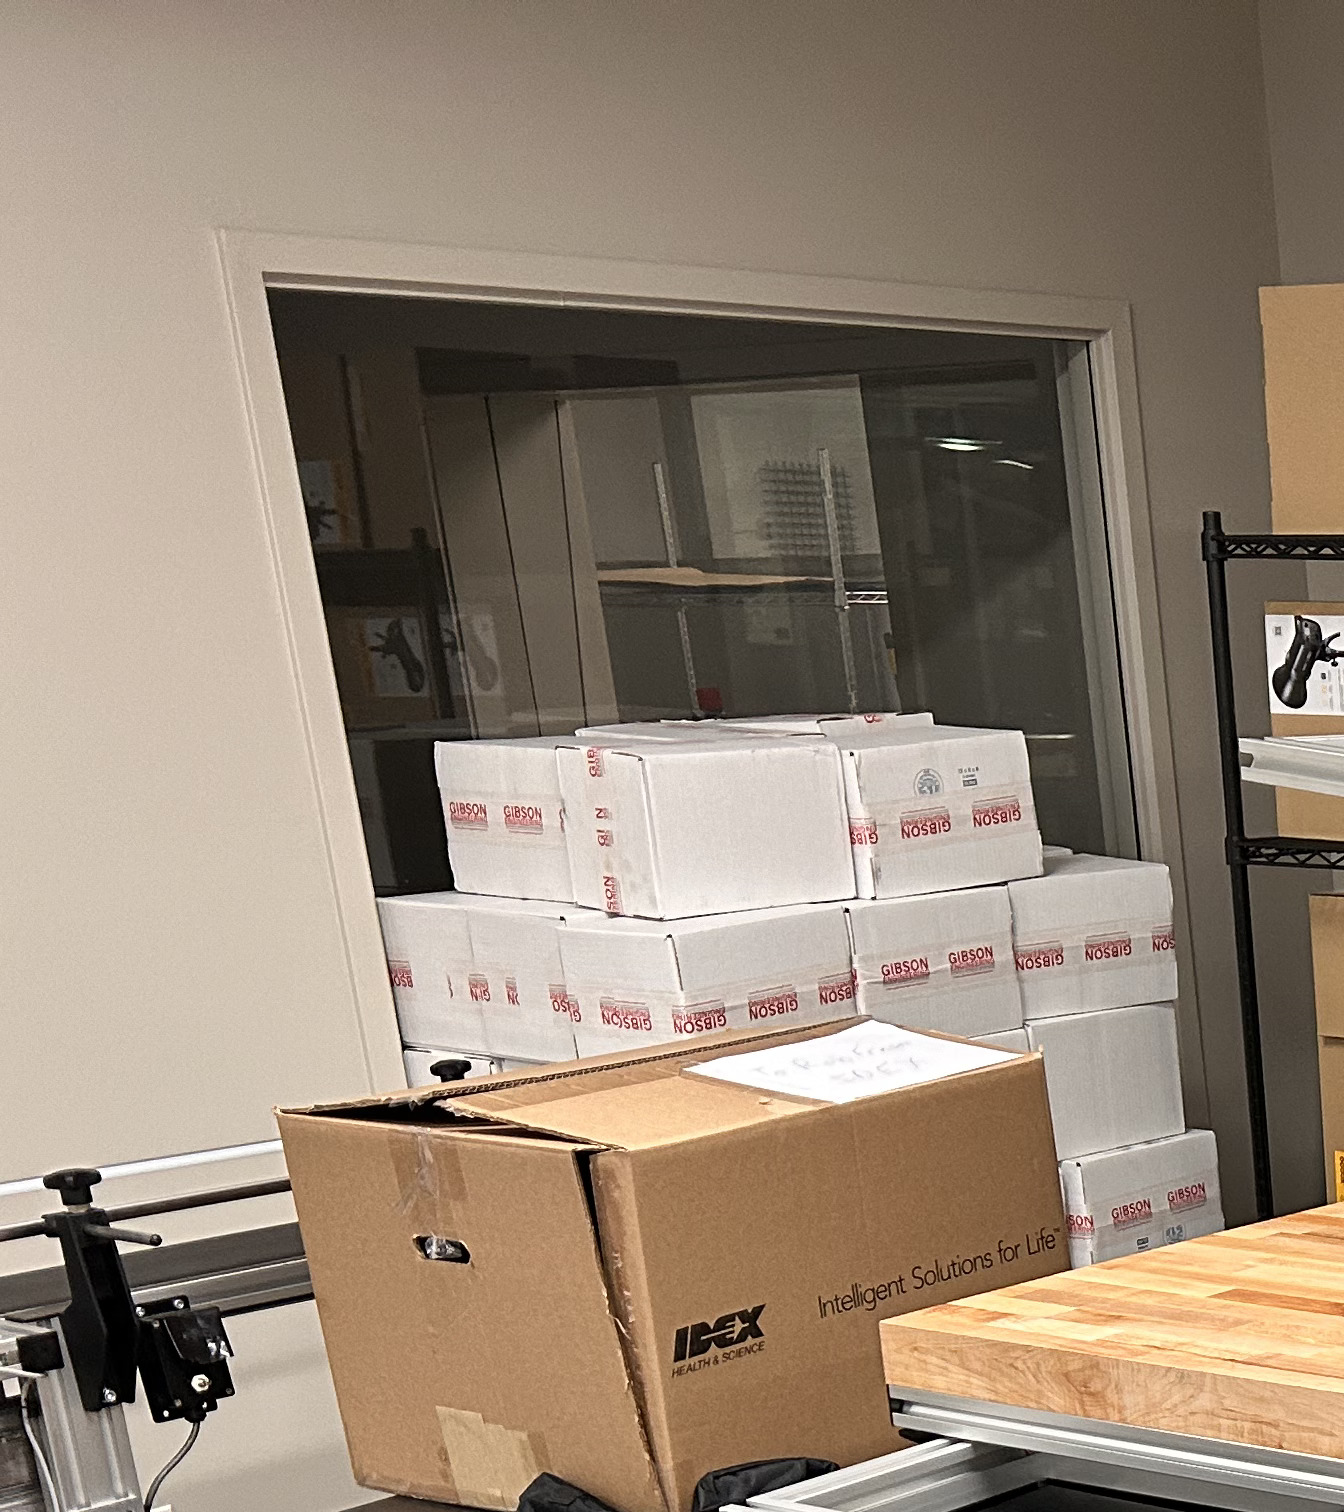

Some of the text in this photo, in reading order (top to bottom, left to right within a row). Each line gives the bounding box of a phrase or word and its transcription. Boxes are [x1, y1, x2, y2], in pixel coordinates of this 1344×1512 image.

[587, 749, 598, 778] GIB
[450, 801, 487, 818] GIBSON
[503, 804, 543, 819] GIBSON
[973, 809, 1021, 827] GIBSON
[850, 831, 878, 845] GIBS
[901, 820, 951, 840] GIBSON
[603, 876, 613, 910] SON
[1085, 945, 1132, 961] GIBSON
[1152, 938, 1176, 952] SON
[949, 946, 993, 964] GIBSON
[1015, 952, 1064, 971] GIBSON
[881, 957, 929, 977] GIBSON
[749, 998, 798, 1020] GIBSON
[674, 1011, 727, 1035] GIBSON
[1167, 1183, 1206, 1202] GIBSON
[1111, 1198, 1150, 1219] GIBSON
[1068, 1214, 1093, 1228] SON
[818, 1273, 907, 1319] Intelligent
[912, 1251, 994, 1291] Solutions
[998, 1239, 1021, 1266] for
[673, 1304, 767, 1363] IDEX
[671, 1341, 765, 1378] HEALTH & SCIENCE
